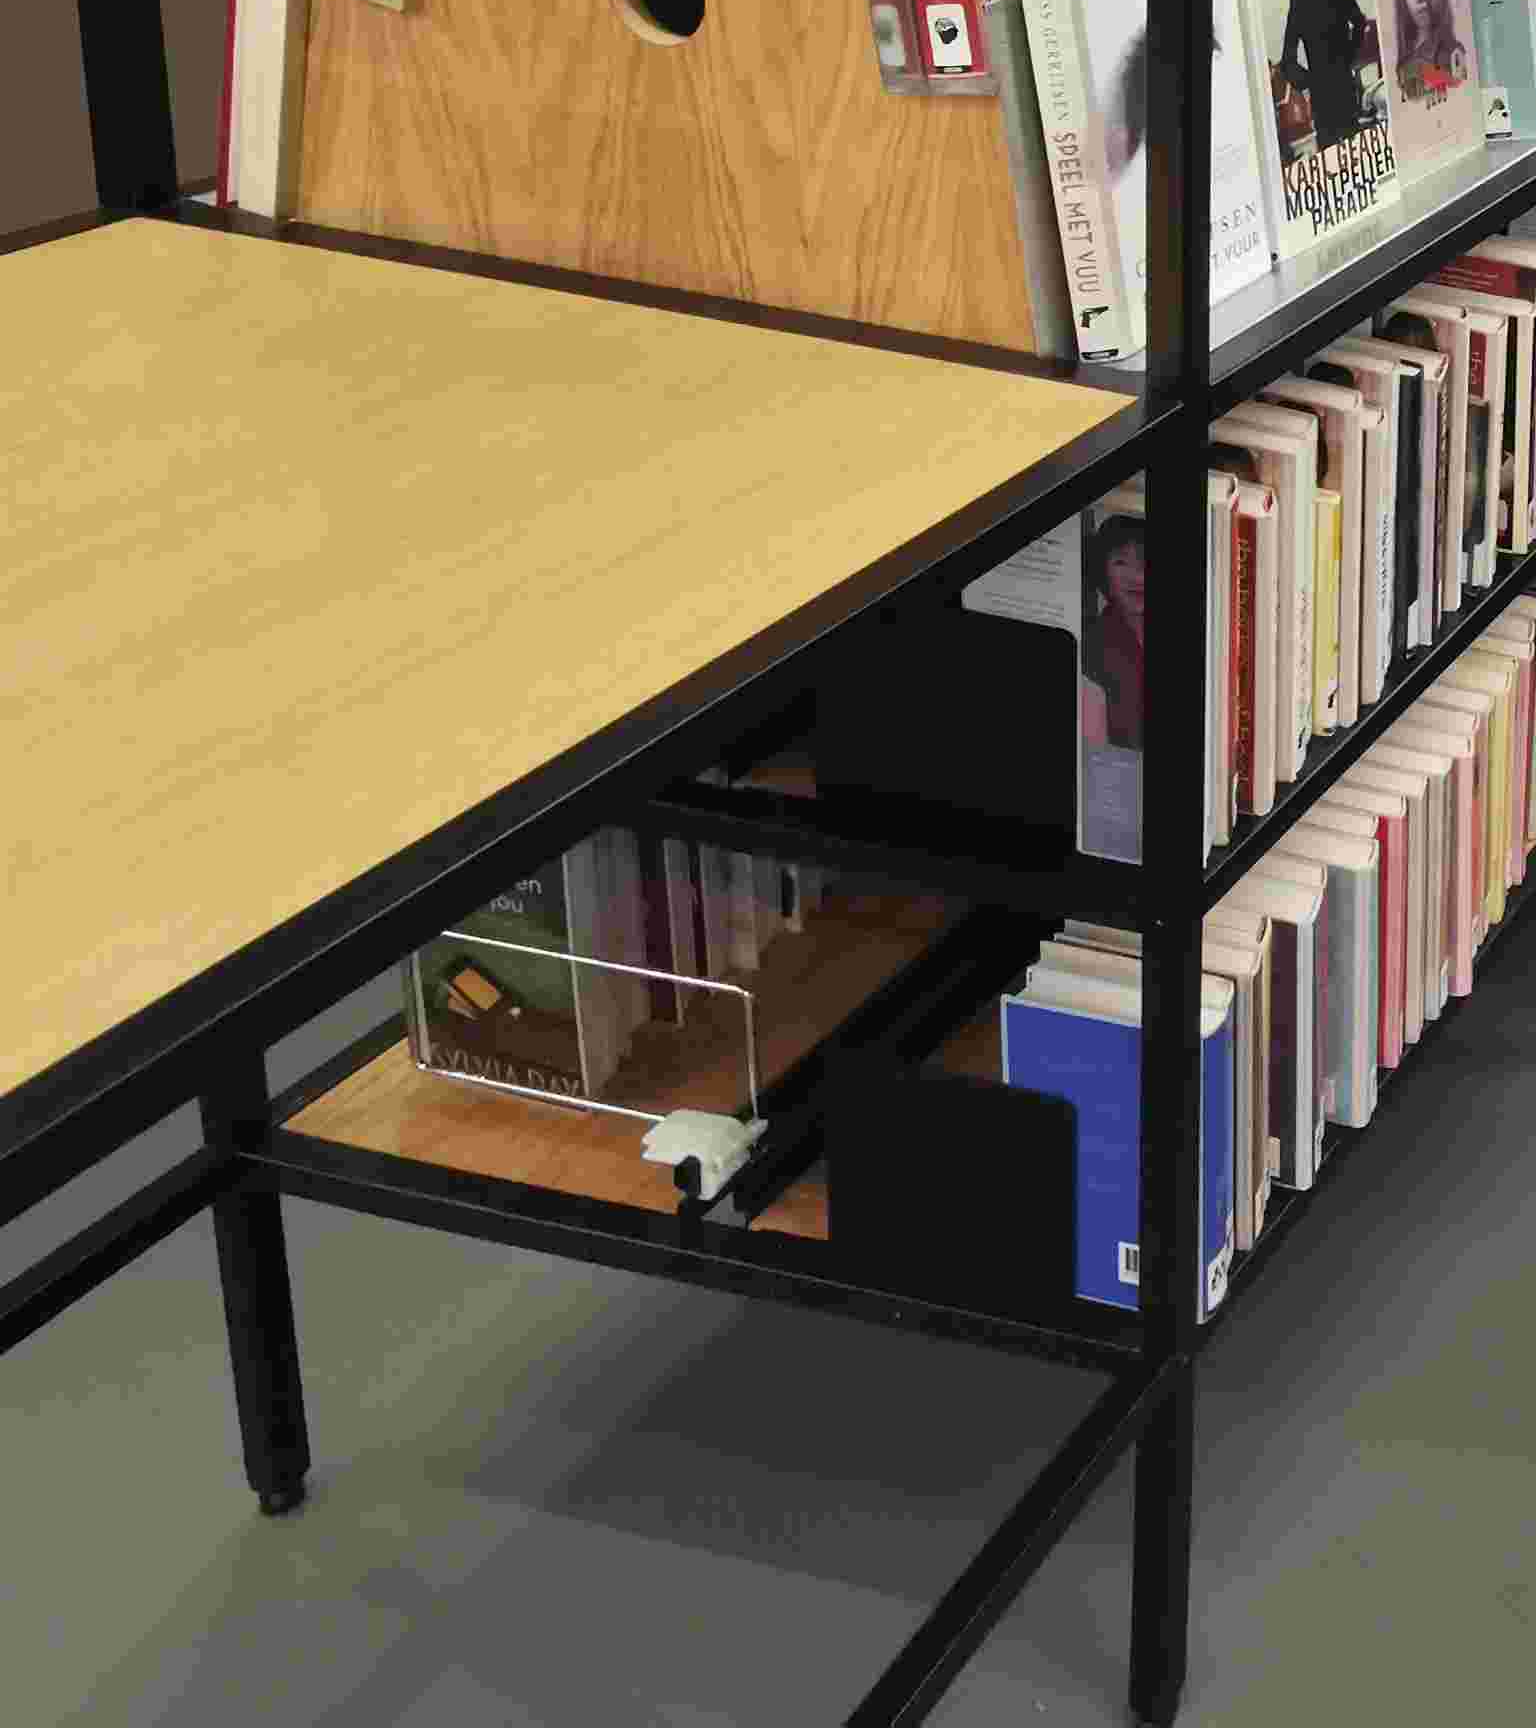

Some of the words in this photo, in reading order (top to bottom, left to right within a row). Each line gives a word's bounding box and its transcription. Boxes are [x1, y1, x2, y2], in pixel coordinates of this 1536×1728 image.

[1041, 27, 1072, 124] GERRITSEN
[1053, 131, 1082, 198] SPEEL
[1281, 150, 1329, 194] KARL
[1336, 123, 1390, 177] GEARY
[1285, 146, 1396, 222] MONTPELIER
[1063, 201, 1094, 246] MET
[1312, 185, 1378, 237] PARADE
[1072, 249, 1101, 297] VUU
[1222, 230, 1262, 265] VUUR
[431, 1041, 514, 1081] SYLVIA
[526, 1068, 581, 1096] DAY
